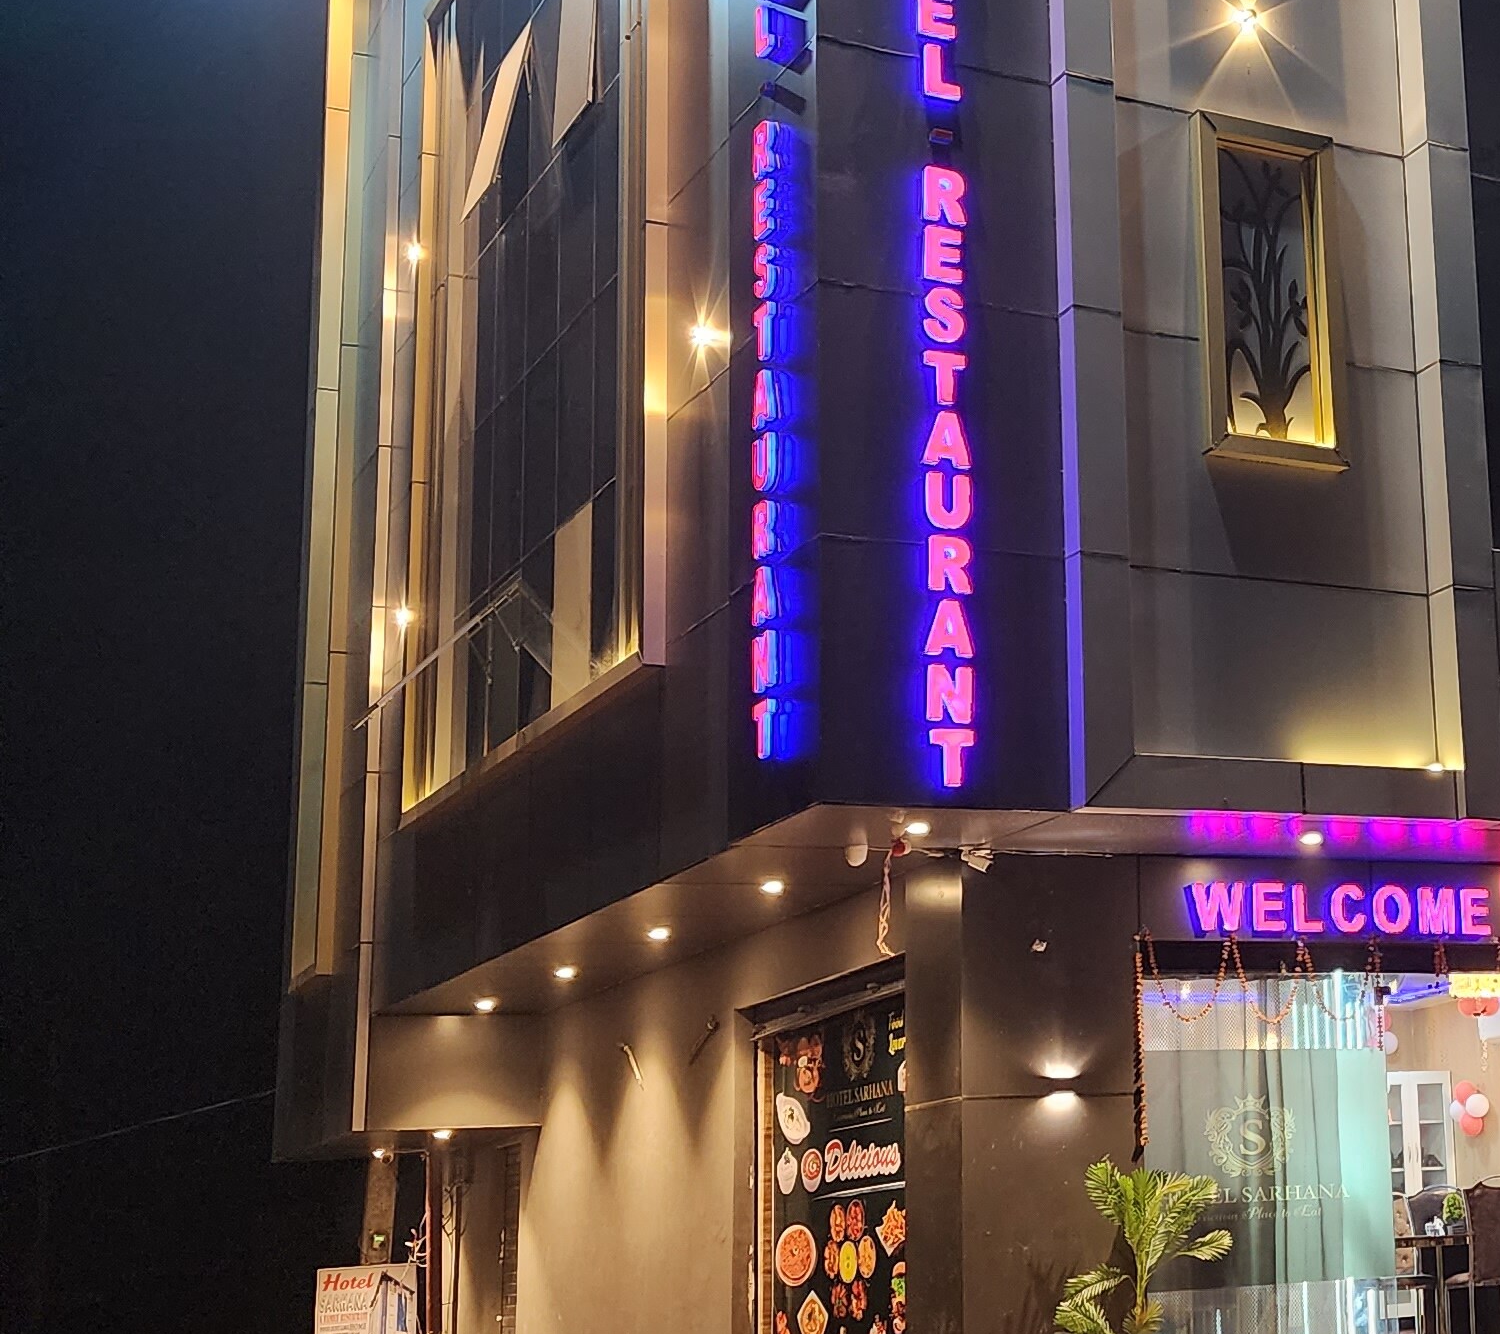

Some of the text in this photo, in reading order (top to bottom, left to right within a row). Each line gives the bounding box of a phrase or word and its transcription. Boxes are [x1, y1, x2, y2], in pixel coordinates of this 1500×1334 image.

[920, 165, 974, 788] RESTAURANT
[1190, 880, 1491, 935] WELCOME
[854, 1078, 894, 1103] SARHANA
[1239, 1118, 1266, 1156] S
[825, 1139, 901, 1183] Delicious
[1241, 1183, 1350, 1203] SARHANA
[322, 1273, 374, 1292] Hotel
